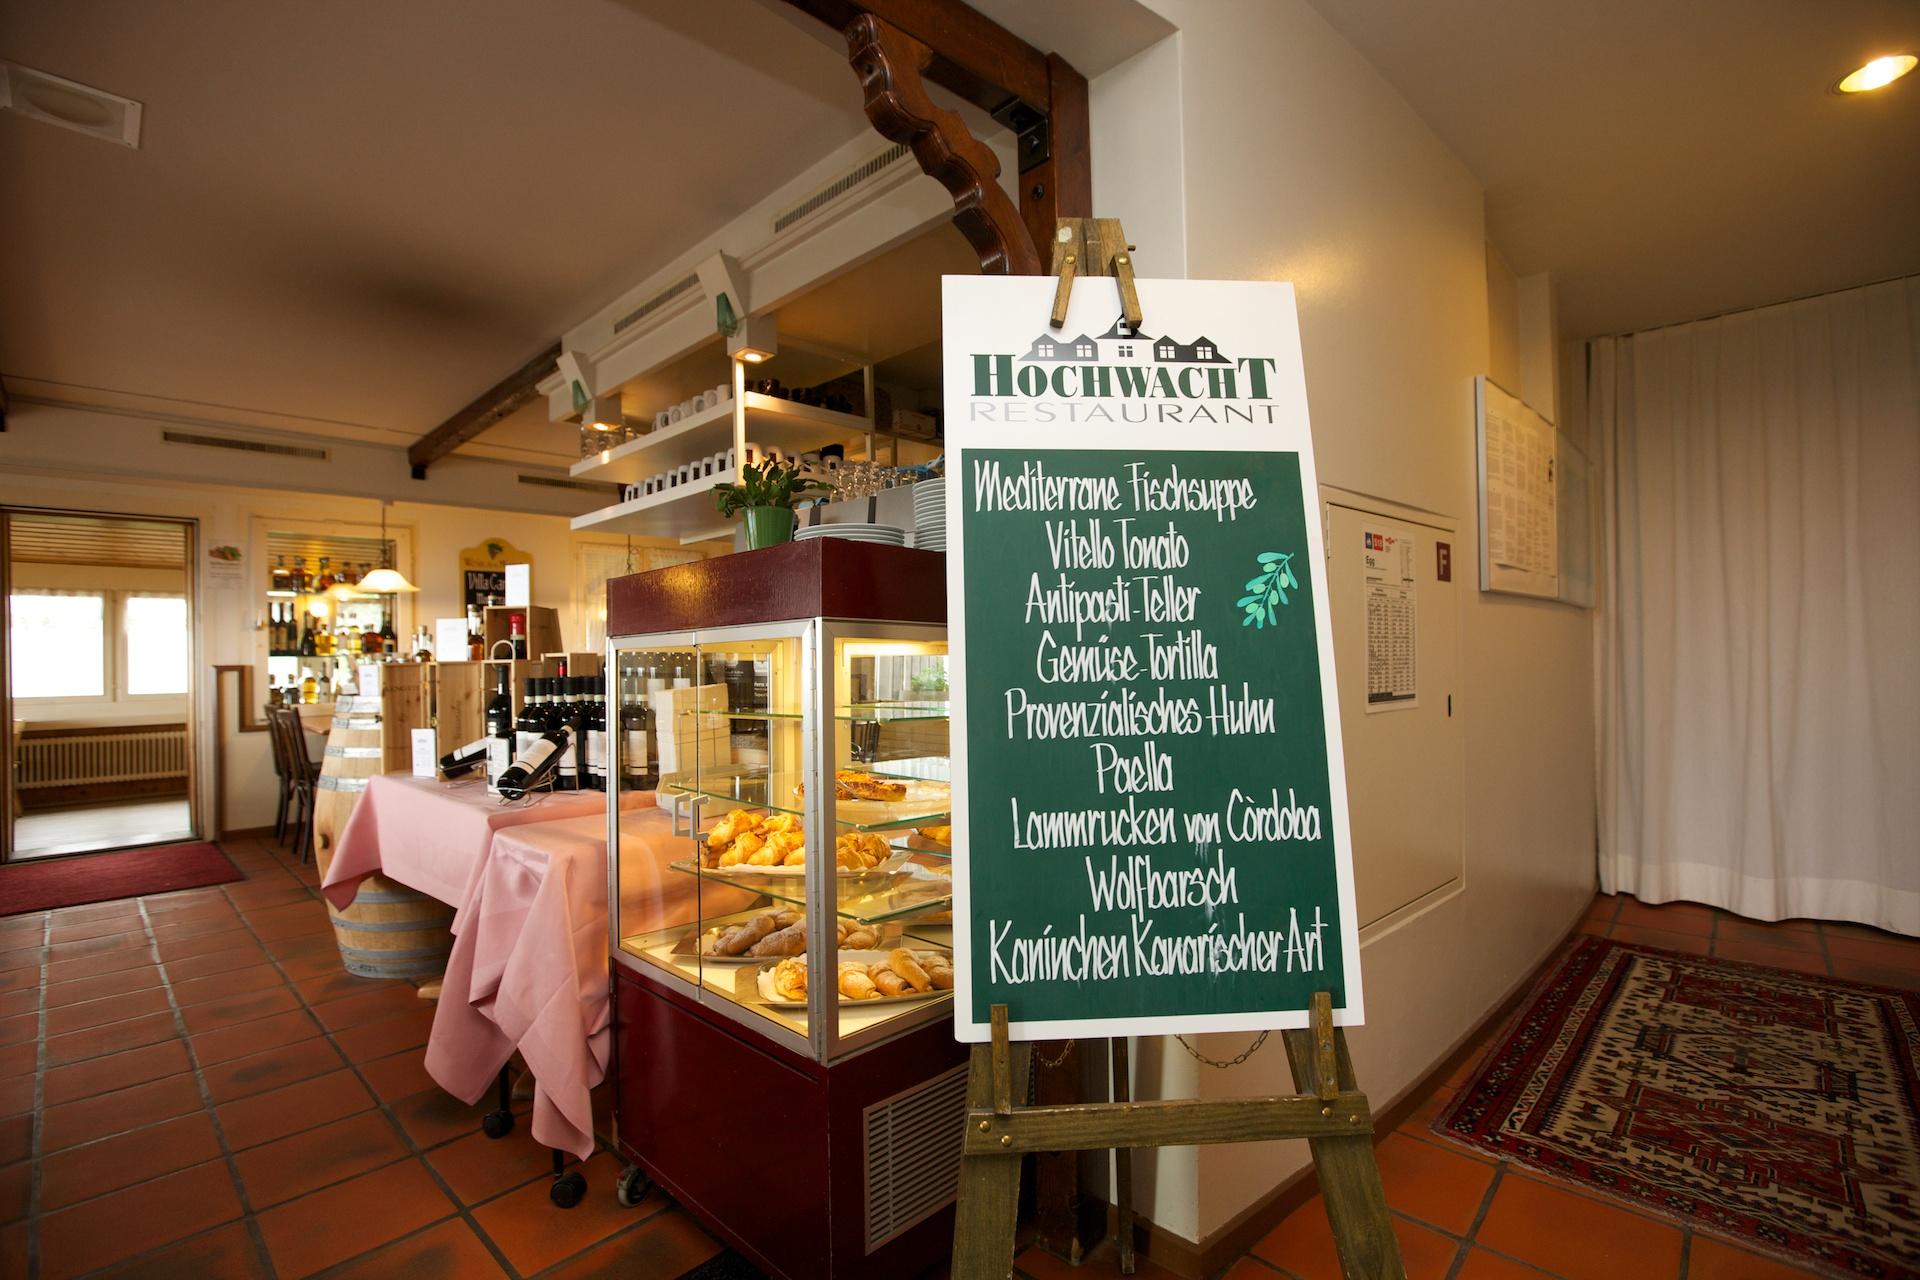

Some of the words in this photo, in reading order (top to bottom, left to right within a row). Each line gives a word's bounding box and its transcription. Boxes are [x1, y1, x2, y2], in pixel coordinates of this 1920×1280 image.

[969, 353, 1277, 400] HOCHWACHT
[970, 401, 1279, 424] RESTAURANT
[973, 458, 1122, 513] Mediterrane
[1123, 460, 1258, 522] Fischsuppe
[1045, 518, 1115, 571] Vitello
[1115, 517, 1190, 571] Tonato
[1438, 548, 1449, 576] F
[1003, 687, 1202, 740] Provenzialisches
[1204, 681, 1276, 737] Huhn
[1089, 740, 1174, 794] Paella
[1010, 795, 1177, 850] Lammrucken
[1183, 810, 1220, 845] von
[1085, 848, 1239, 923] Wolfbarsch
[989, 913, 1130, 985] Kaninchen
[1131, 912, 1283, 979] Kanarischer
[1282, 905, 1328, 973] Art
